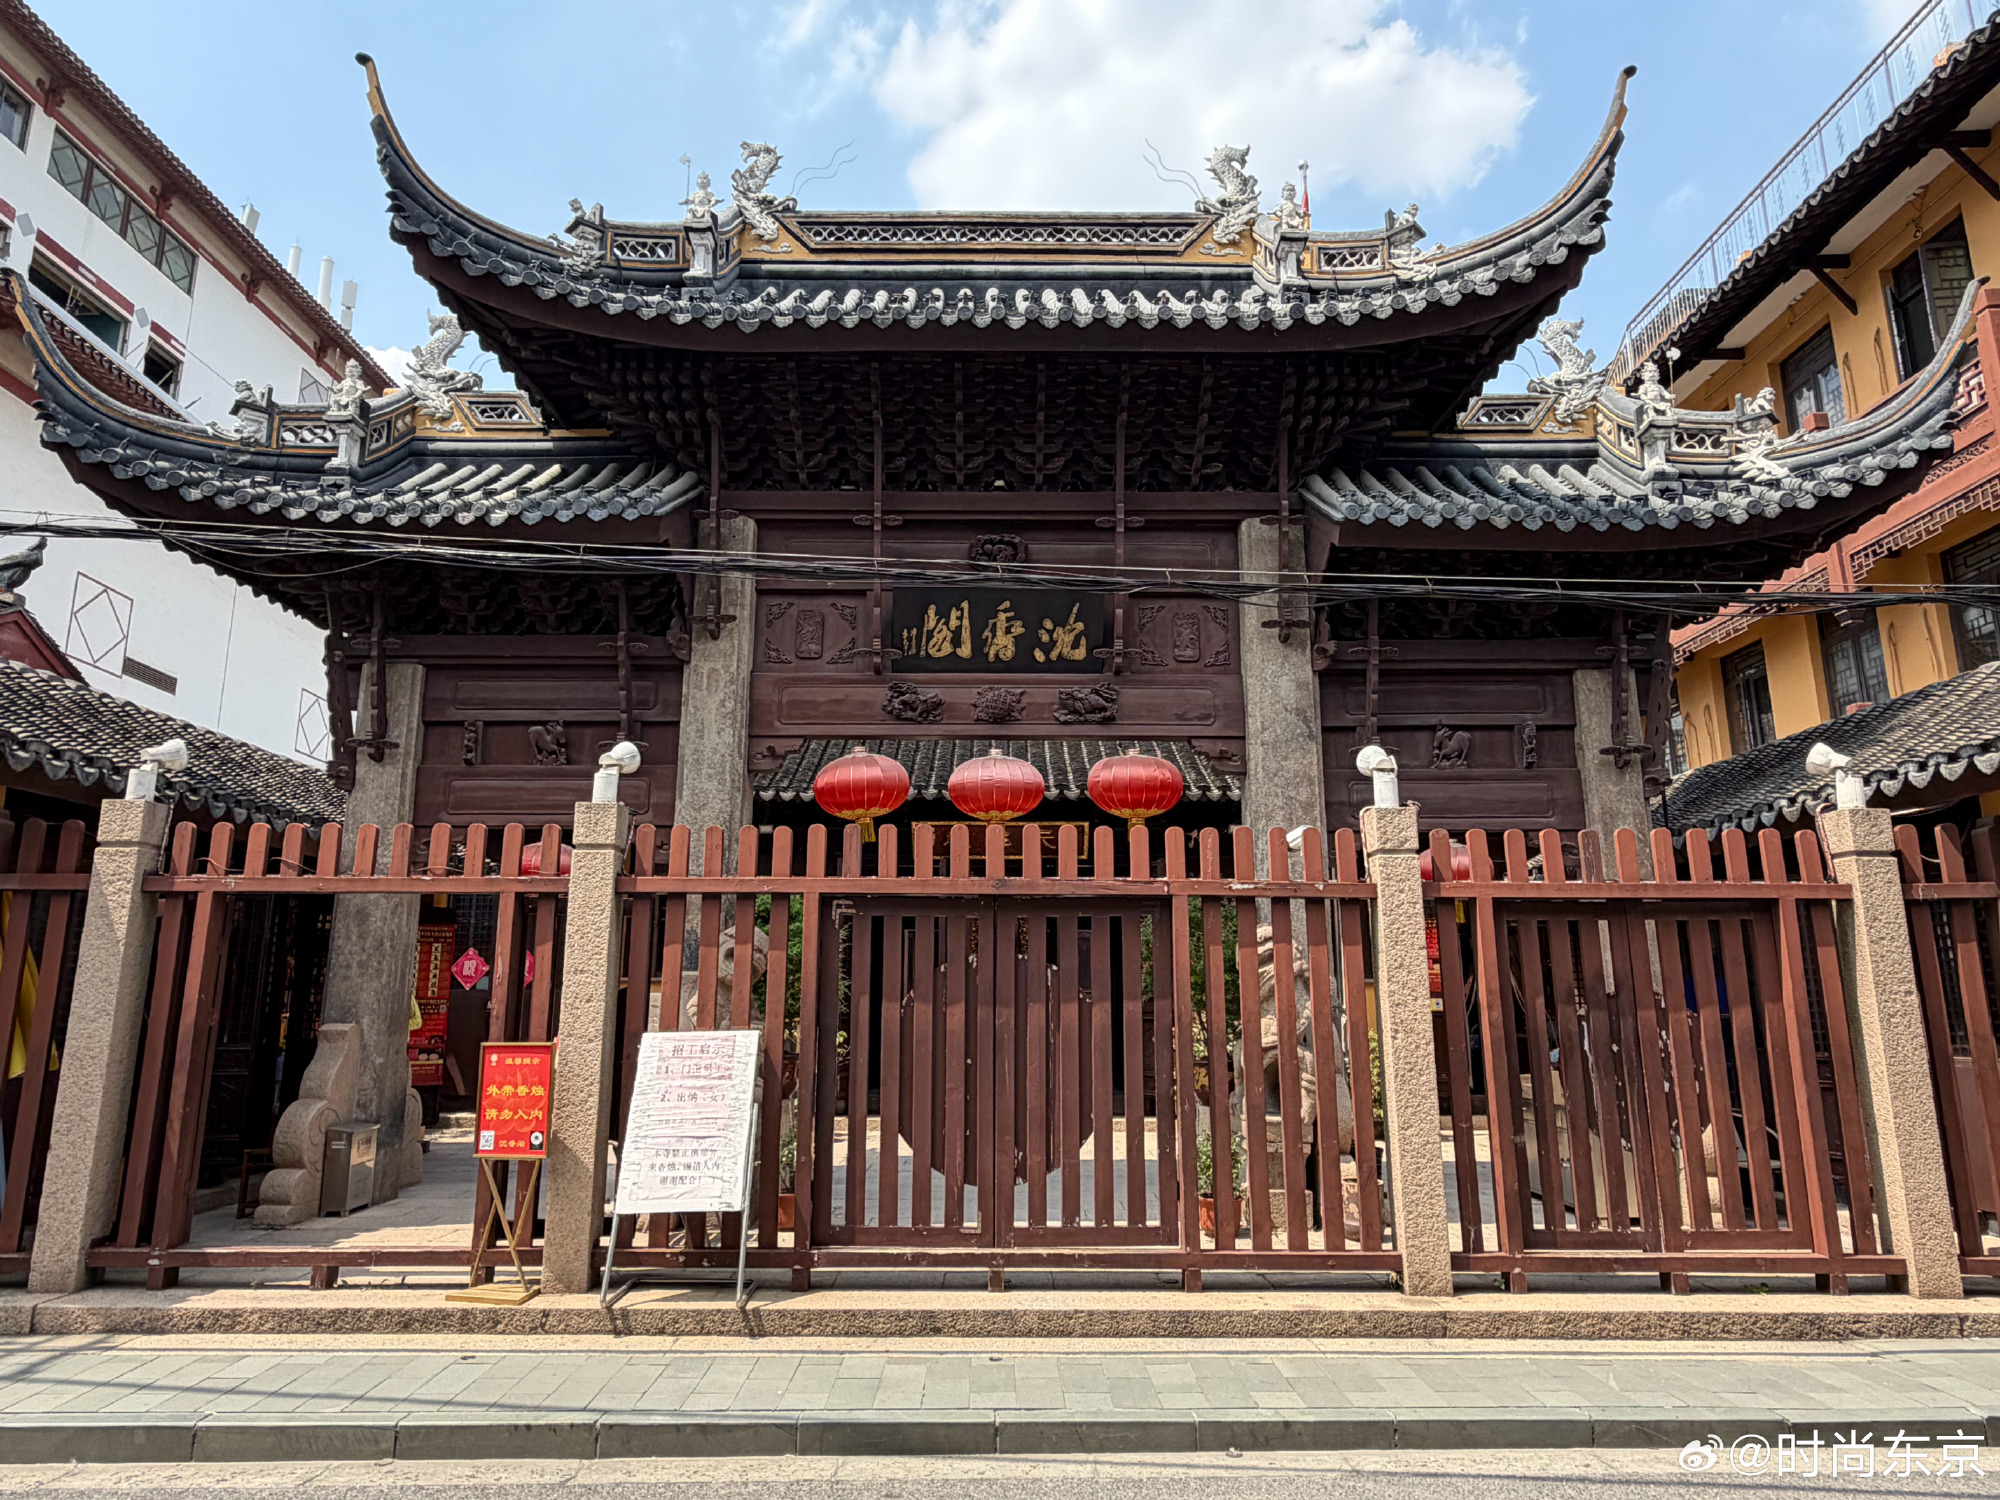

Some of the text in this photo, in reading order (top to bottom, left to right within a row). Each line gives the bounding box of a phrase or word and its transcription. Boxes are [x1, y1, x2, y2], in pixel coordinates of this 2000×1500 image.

[505, 1057, 541, 1065] 温馨提示
[486, 1085, 545, 1097] 外带香烛
[485, 1109, 543, 1121] 请勿入内
